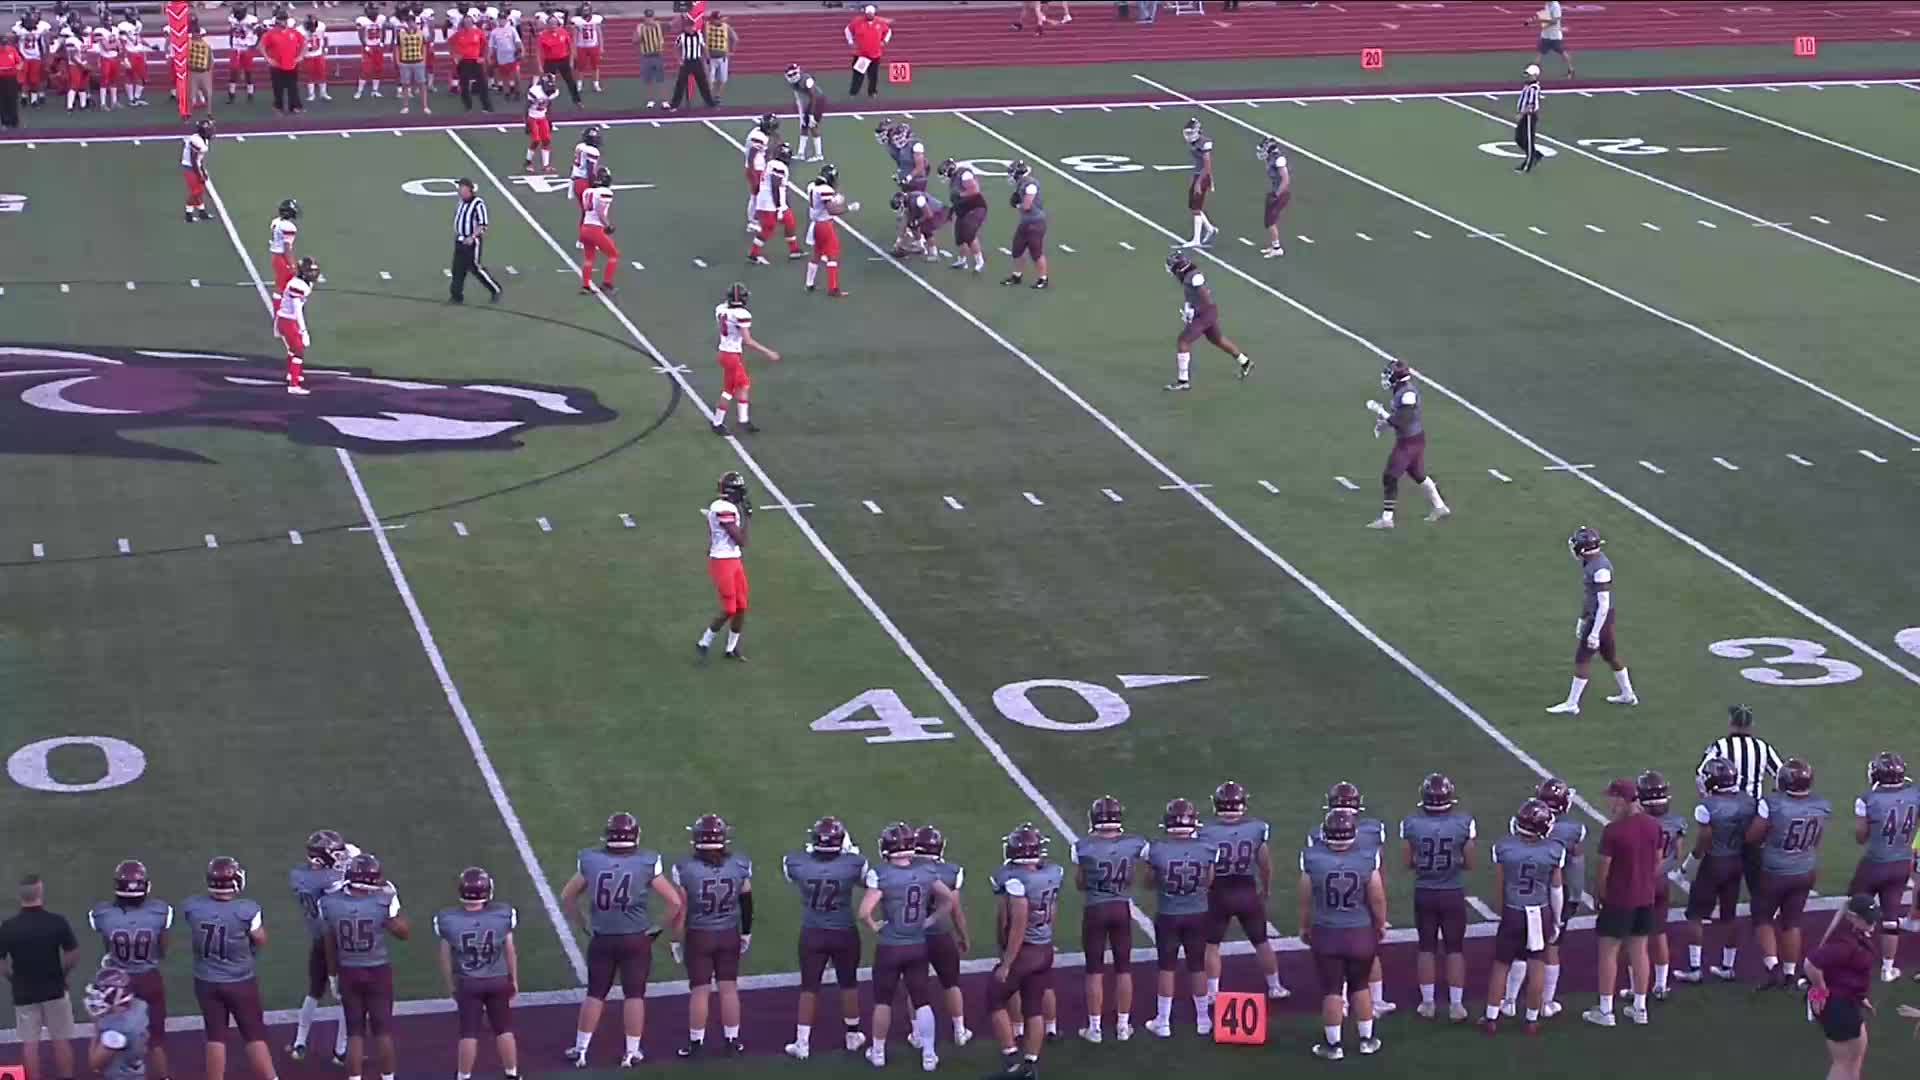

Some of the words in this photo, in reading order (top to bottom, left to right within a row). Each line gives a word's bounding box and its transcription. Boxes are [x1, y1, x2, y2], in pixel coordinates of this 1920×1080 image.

[1366, 51, 1380, 66] 20
[1799, 38, 1813, 53] 10
[892, 63, 906, 80] 30
[1881, 804, 1915, 847] 44
[594, 871, 632, 912] 64
[701, 877, 736, 915] 52
[806, 878, 841, 913] 72
[1166, 859, 1201, 896] 53
[1324, 869, 1360, 912] 62
[1518, 863, 1538, 897] 5
[904, 884, 923, 925] 8
[199, 919, 227, 961] 71
[338, 918, 375, 953] 85
[459, 928, 498, 971] 54
[1221, 997, 1258, 1036] 40
